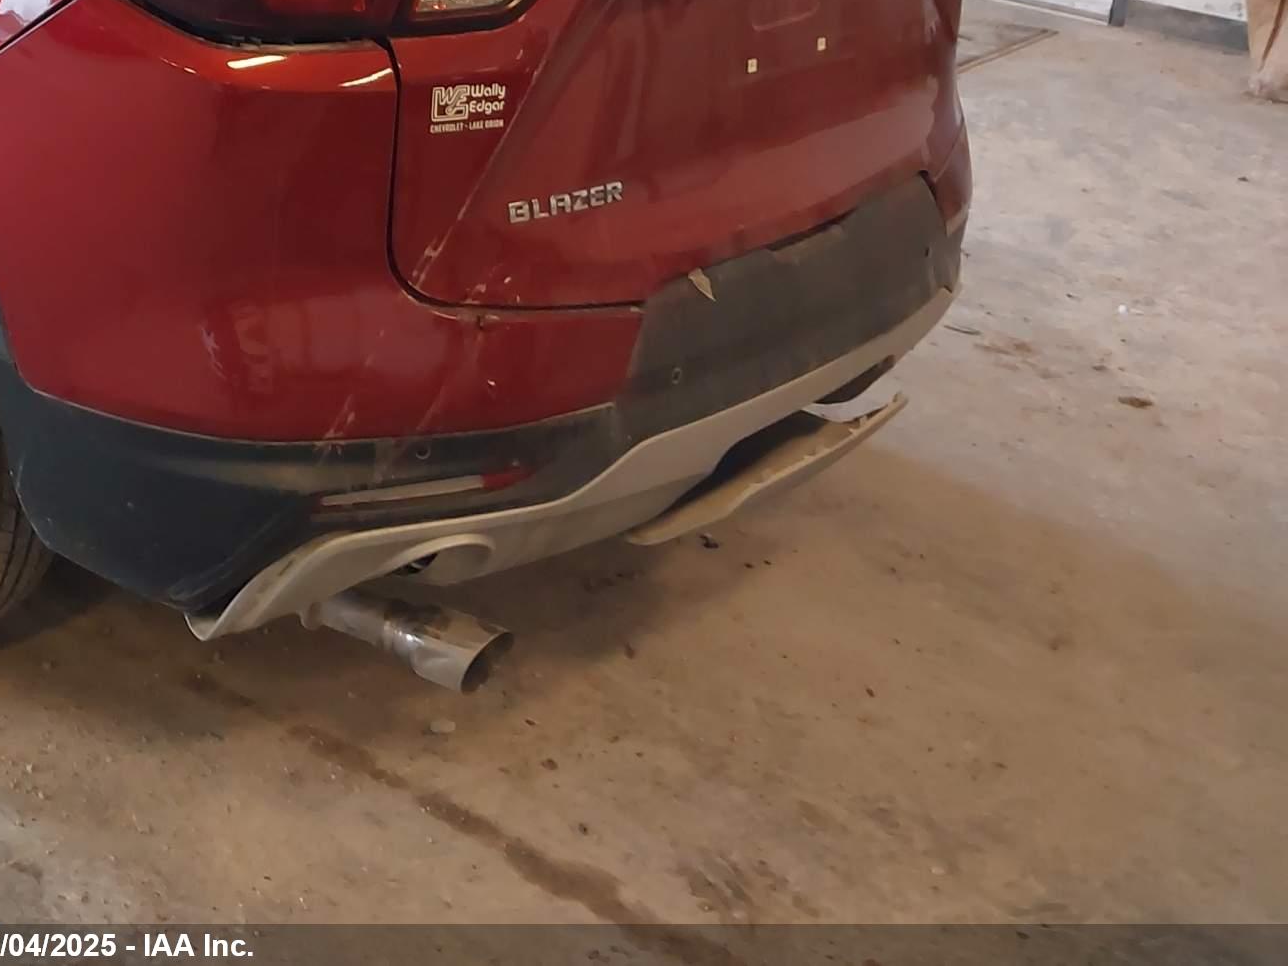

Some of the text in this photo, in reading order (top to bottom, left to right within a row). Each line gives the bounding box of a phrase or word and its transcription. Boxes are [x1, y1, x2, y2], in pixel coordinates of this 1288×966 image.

[471, 83, 506, 99] Wally
[469, 100, 505, 115] Edgar
[508, 181, 623, 223] BLAZER
